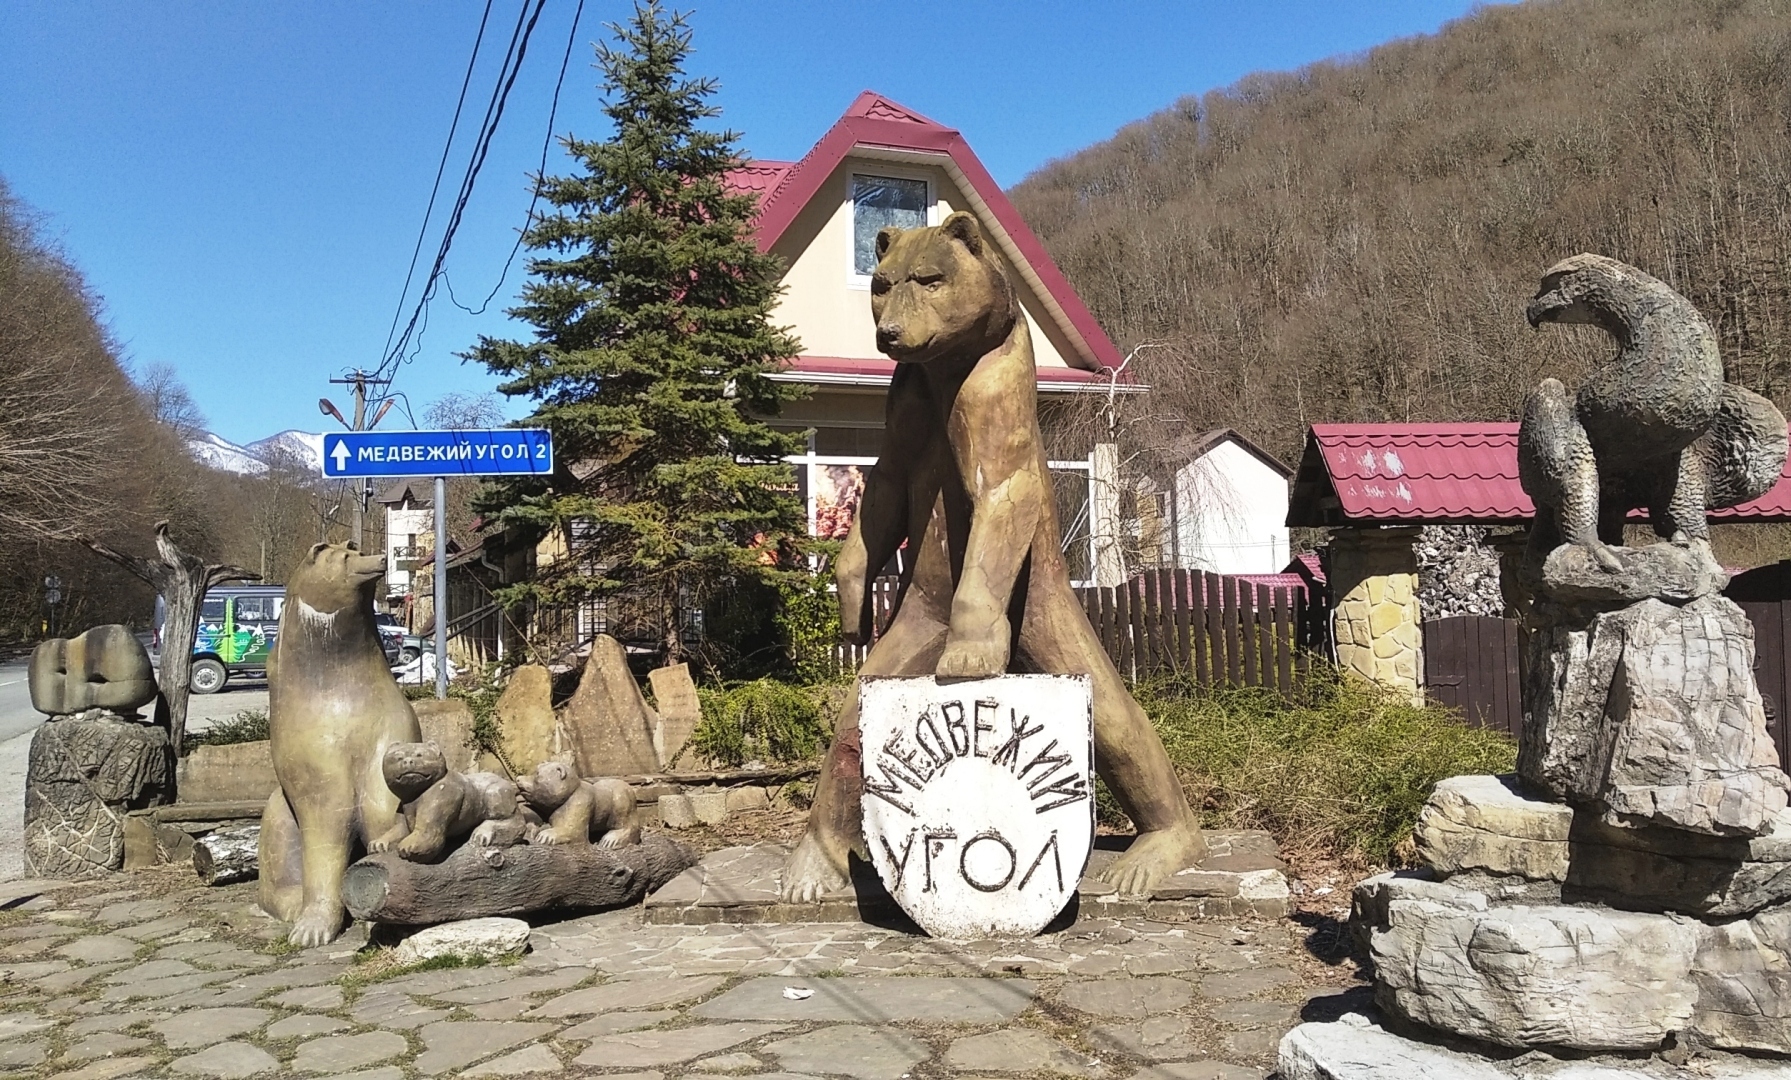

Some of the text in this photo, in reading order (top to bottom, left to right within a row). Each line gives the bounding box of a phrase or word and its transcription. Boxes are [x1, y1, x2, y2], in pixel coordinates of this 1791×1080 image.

[357, 441, 546, 463] МЕДВЕЖИЙ УГОЛ 2
[864, 699, 1088, 816] МЕДВЕЖИЙ
[879, 831, 1065, 894] УГОЛ
